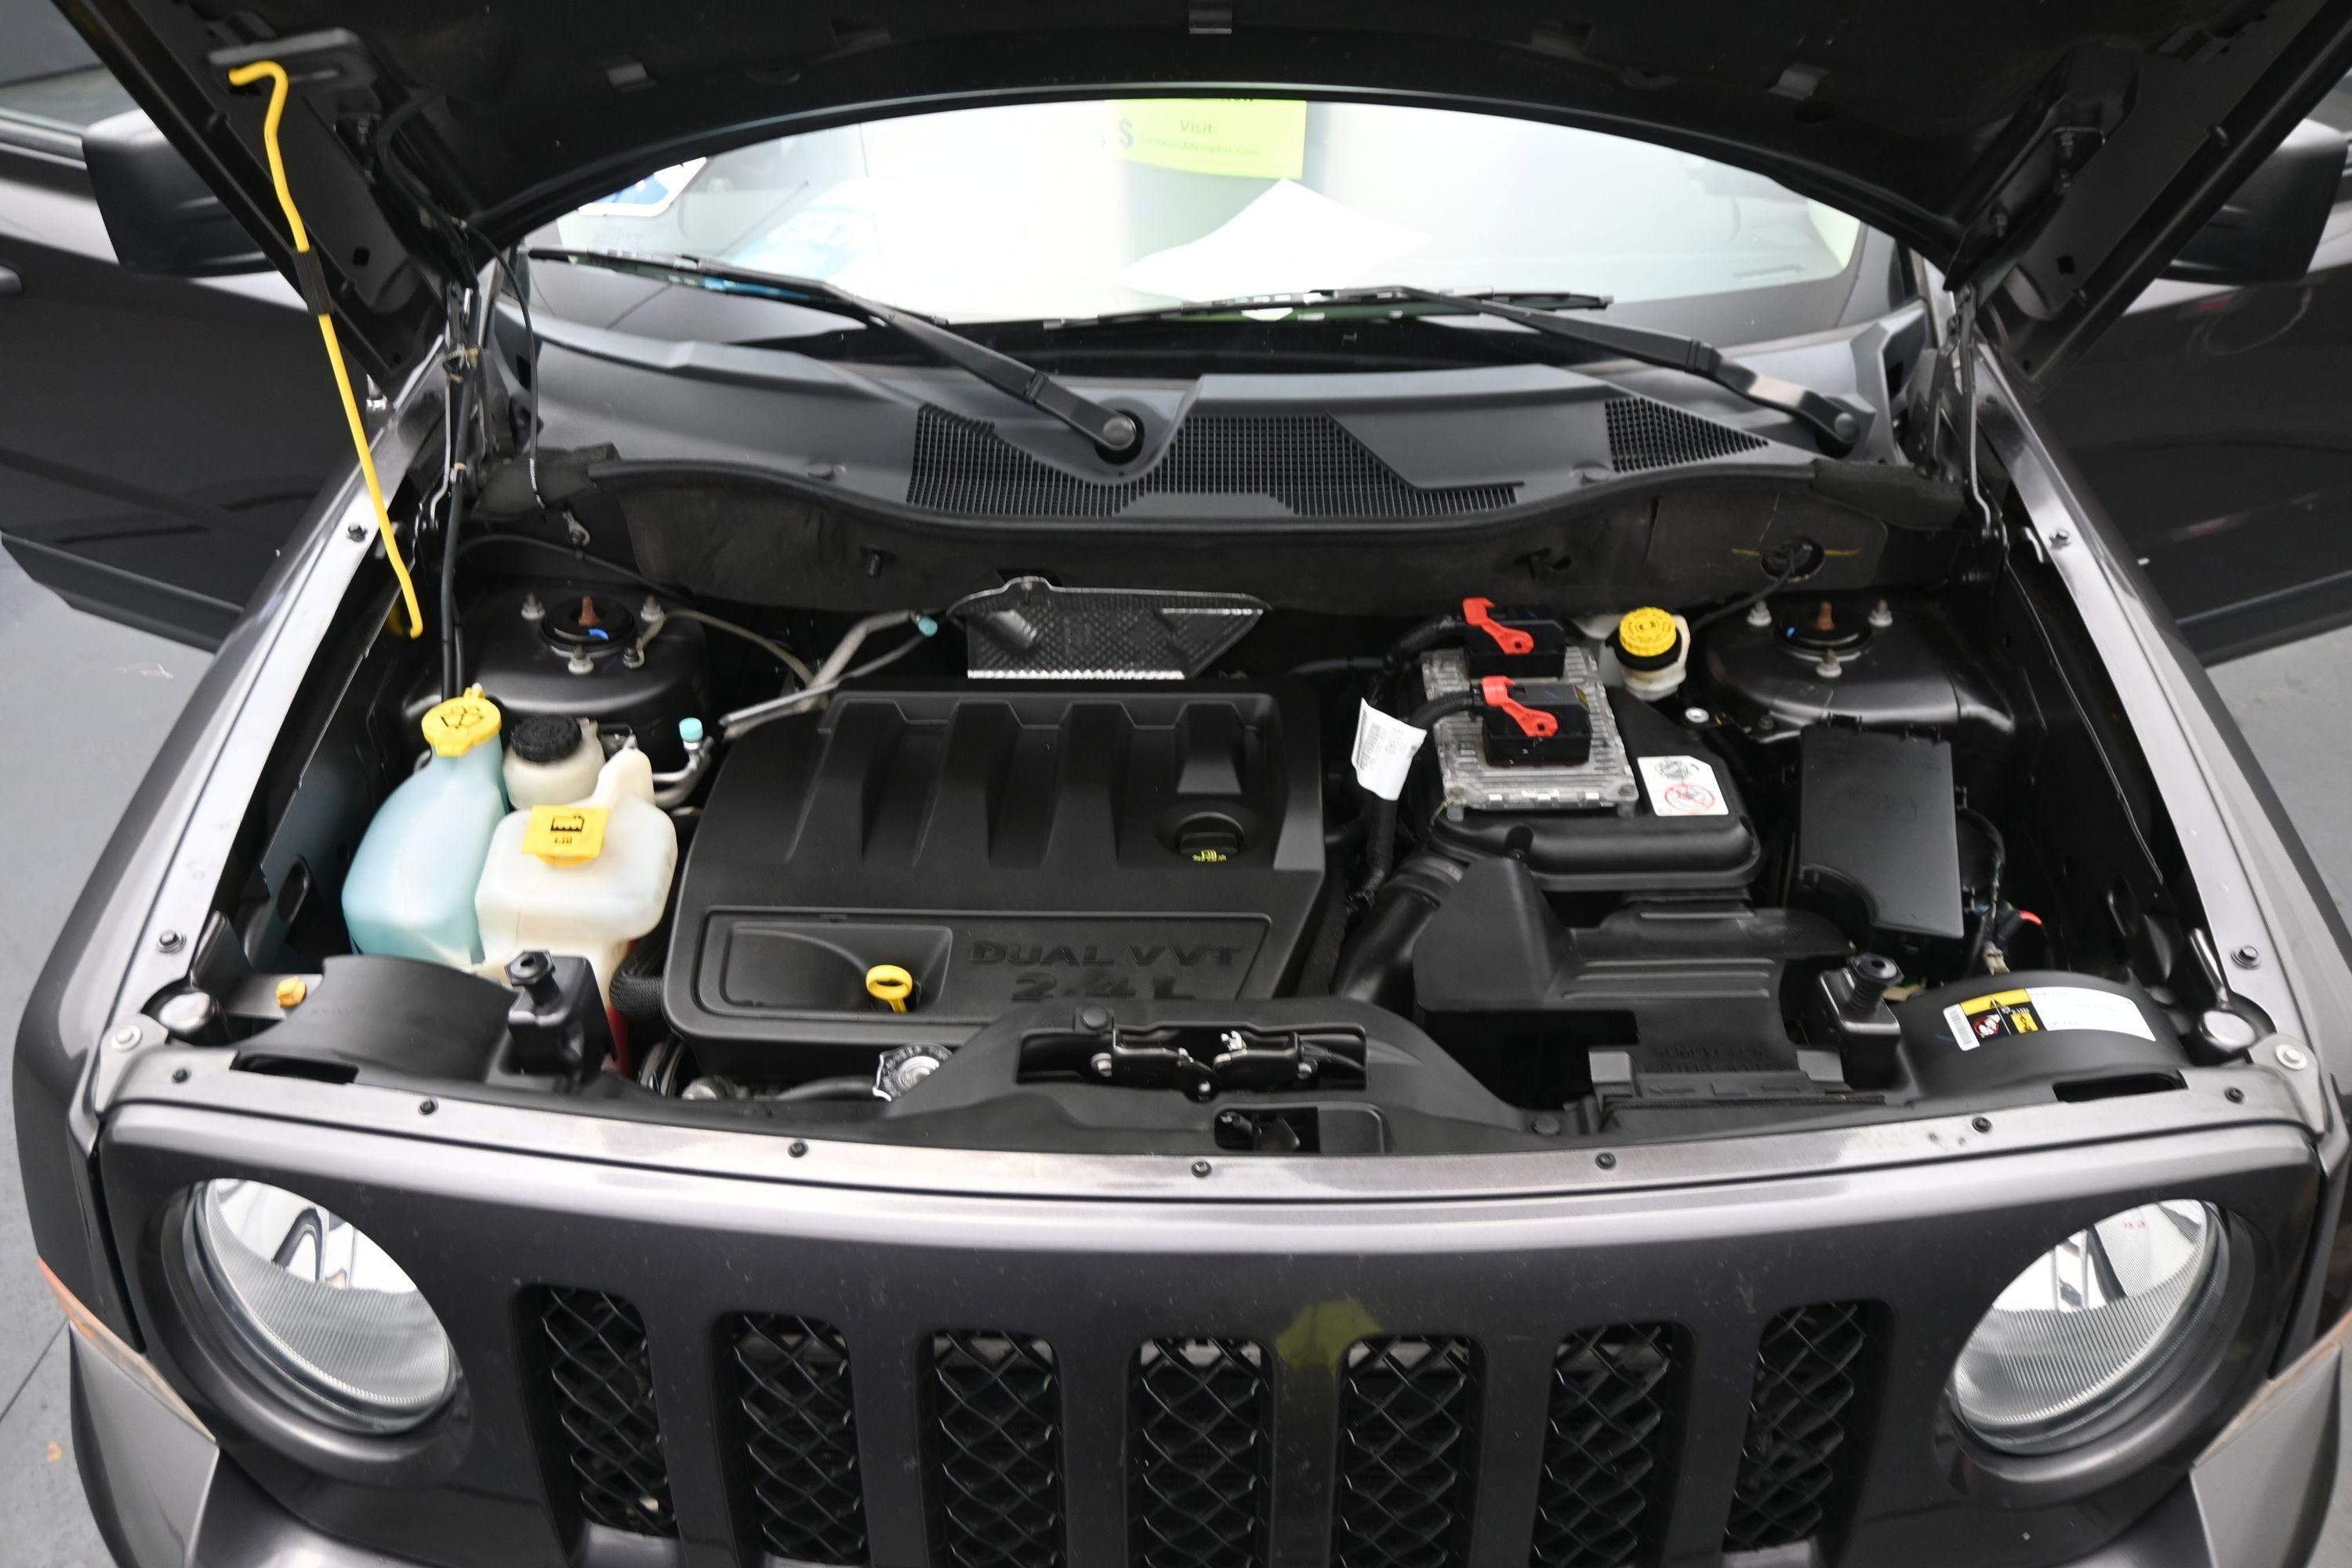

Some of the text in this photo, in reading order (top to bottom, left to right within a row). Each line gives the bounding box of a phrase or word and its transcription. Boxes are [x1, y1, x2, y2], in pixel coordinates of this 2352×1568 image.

[970, 941, 1242, 967] DUAL VVT
[1011, 972, 1196, 1003] 2.4L
